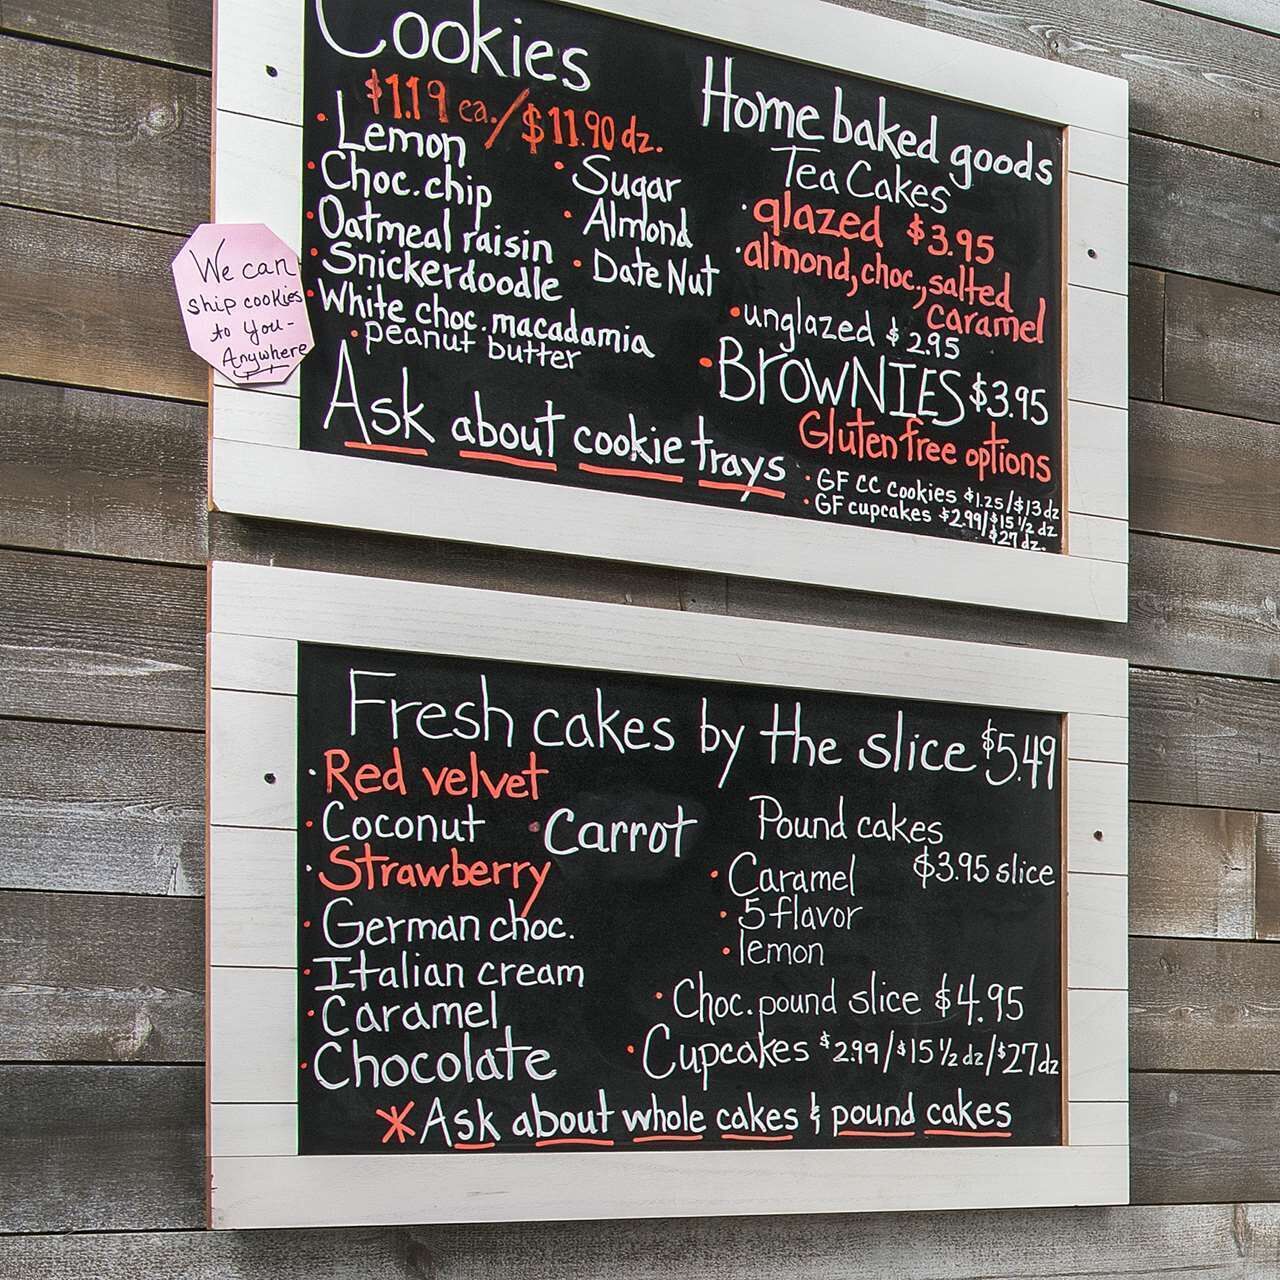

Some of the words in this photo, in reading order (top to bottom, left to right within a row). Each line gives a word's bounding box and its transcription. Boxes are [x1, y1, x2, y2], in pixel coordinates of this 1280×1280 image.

[316, 0, 591, 92] Cookies
[364, 68, 448, 124] $1.19
[702, 56, 824, 141] Home
[834, 86, 939, 164] baked
[950, 140, 1054, 190] goods
[337, 90, 465, 168] Lemon
[572, 155, 682, 218] Sugar
[771, 145, 838, 197] Tea
[846, 160, 951, 214] Cakes
[318, 195, 453, 253] Oatmeal
[463, 229, 554, 266] raisin
[583, 197, 694, 249] Almond
[907, 212, 995, 264] $3.95
[189, 238, 234, 284] We
[242, 258, 297, 280] can
[322, 241, 561, 301] Snickerdoodle
[593, 249, 662, 289] Date
[668, 254, 720, 297] Nut
[186, 294, 237, 316] ship
[243, 285, 304, 309] cookies
[317, 279, 408, 326] White
[416, 293, 488, 333] choc.
[493, 309, 655, 359] macadamia
[744, 296, 876, 353] unglazed
[926, 298, 1046, 344] caramel
[210, 323, 231, 343] to
[222, 343, 308, 374] Anywhere
[365, 322, 475, 355] peanut
[488, 330, 582, 370] butter
[323, 339, 436, 444] Ask
[452, 391, 565, 457] about
[575, 414, 686, 466] cookie
[694, 416, 787, 501] trays
[969, 372, 1049, 426] $3.95
[799, 407, 899, 461] Gluten
[900, 417, 957, 465] free
[966, 420, 1052, 483] options
[814, 493, 845, 516] GF
[848, 500, 932, 523] cupcakes
[816, 468, 850, 493] GF
[855, 474, 882, 495] CC
[887, 479, 958, 504] cookies
[350, 668, 513, 748] Fresh
[533, 688, 675, 755] cakes
[700, 697, 745, 790] by
[760, 702, 842, 768] the
[858, 710, 976, 773] slice
[982, 718, 1057, 790] $5.49
[324, 747, 407, 801] Red
[422, 750, 550, 800] velvet
[322, 800, 486, 843] Coconut
[544, 804, 698, 858] Carrot
[749, 795, 848, 841] Pound
[857, 802, 944, 845] cakes
[318, 843, 552, 918] Strawberry
[728, 852, 856, 898] Caramel
[913, 846, 990, 889] $3.95
[996, 852, 1056, 888] slice
[322, 896, 481, 949] German
[489, 898, 575, 943] choc.
[738, 898, 766, 932] 5
[769, 894, 864, 930] flavor
[312, 949, 465, 992] Italian
[476, 960, 585, 988] cream
[739, 929, 825, 967] lemon
[321, 989, 499, 1037] Caramel
[758, 977, 838, 1033] pound
[848, 970, 922, 1015] slice
[936, 972, 1025, 1026] $4.95
[313, 1025, 558, 1090] Chocolate
[643, 1023, 811, 1091] Cupcakes
[419, 1096, 501, 1148] Ask
[512, 1088, 615, 1139] about
[621, 1092, 707, 1135] whole
[716, 1091, 800, 1135] cakes
[833, 1091, 916, 1137] pound
[926, 1087, 1013, 1129] cakes
